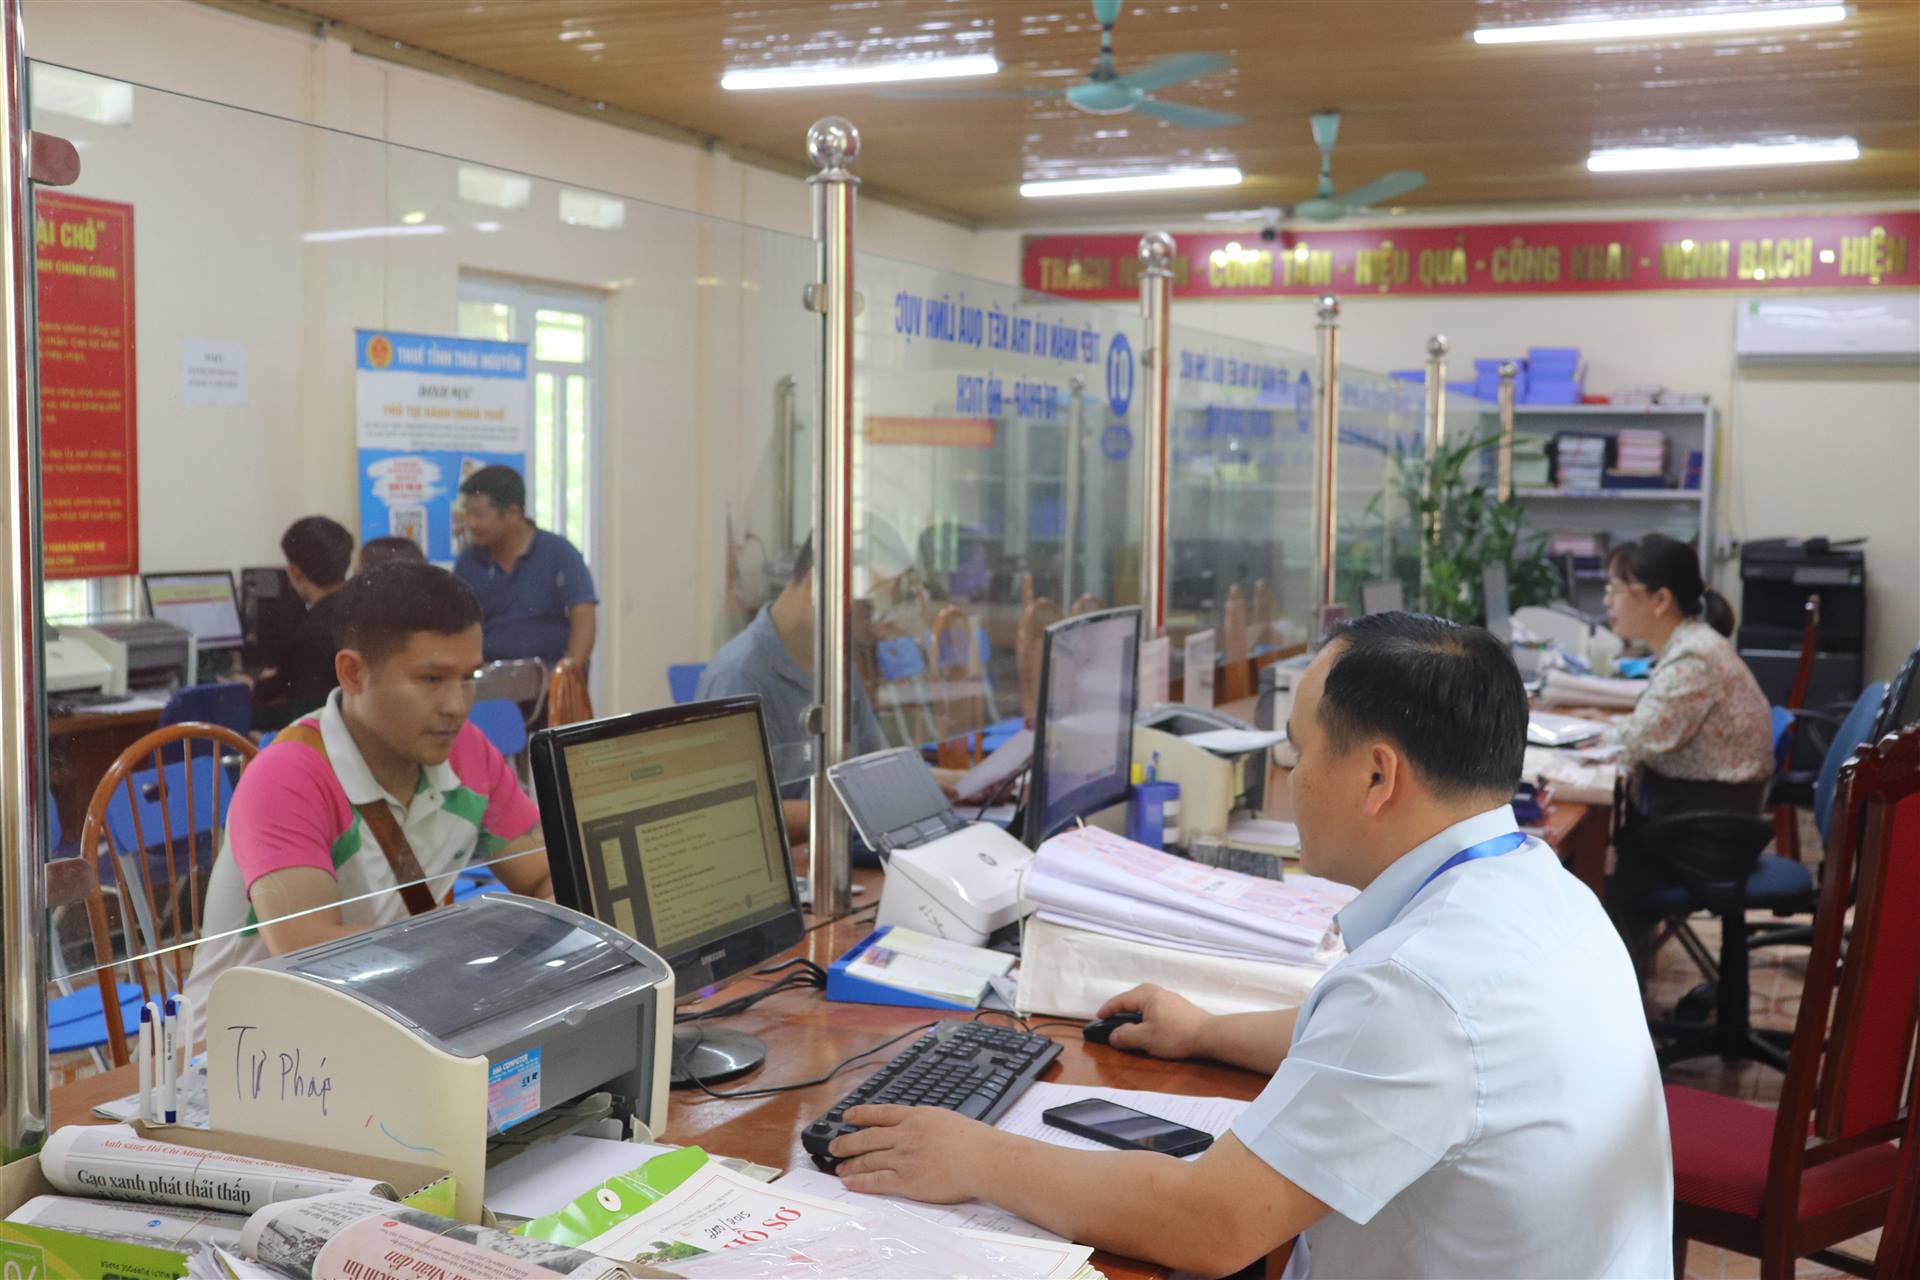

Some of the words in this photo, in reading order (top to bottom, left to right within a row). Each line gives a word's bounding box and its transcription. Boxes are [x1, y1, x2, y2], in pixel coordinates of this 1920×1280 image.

[1208, 243, 1272, 288] CÔNG
[1281, 242, 1333, 287] TÂM
[1354, 240, 1410, 293] HIỆU
[1419, 236, 1468, 285] QUẢ
[1491, 237, 1560, 282] CÔNG
[1569, 243, 1633, 281] KHAI
[1657, 240, 1730, 280] MINH
[1737, 237, 1812, 285] BẠCH
[1838, 226, 1909, 285] HIỆN
[279, 1048, 333, 1117] Pháp
[77, 1169, 106, 1188] Gạo
[109, 1173, 145, 1192] xanh
[149, 1174, 183, 1196] phát
[185, 1177, 214, 1199] thải
[217, 1177, 251, 1206] thấp
[762, 1206, 802, 1231] SƠ
[384, 1250, 414, 1271] dân
